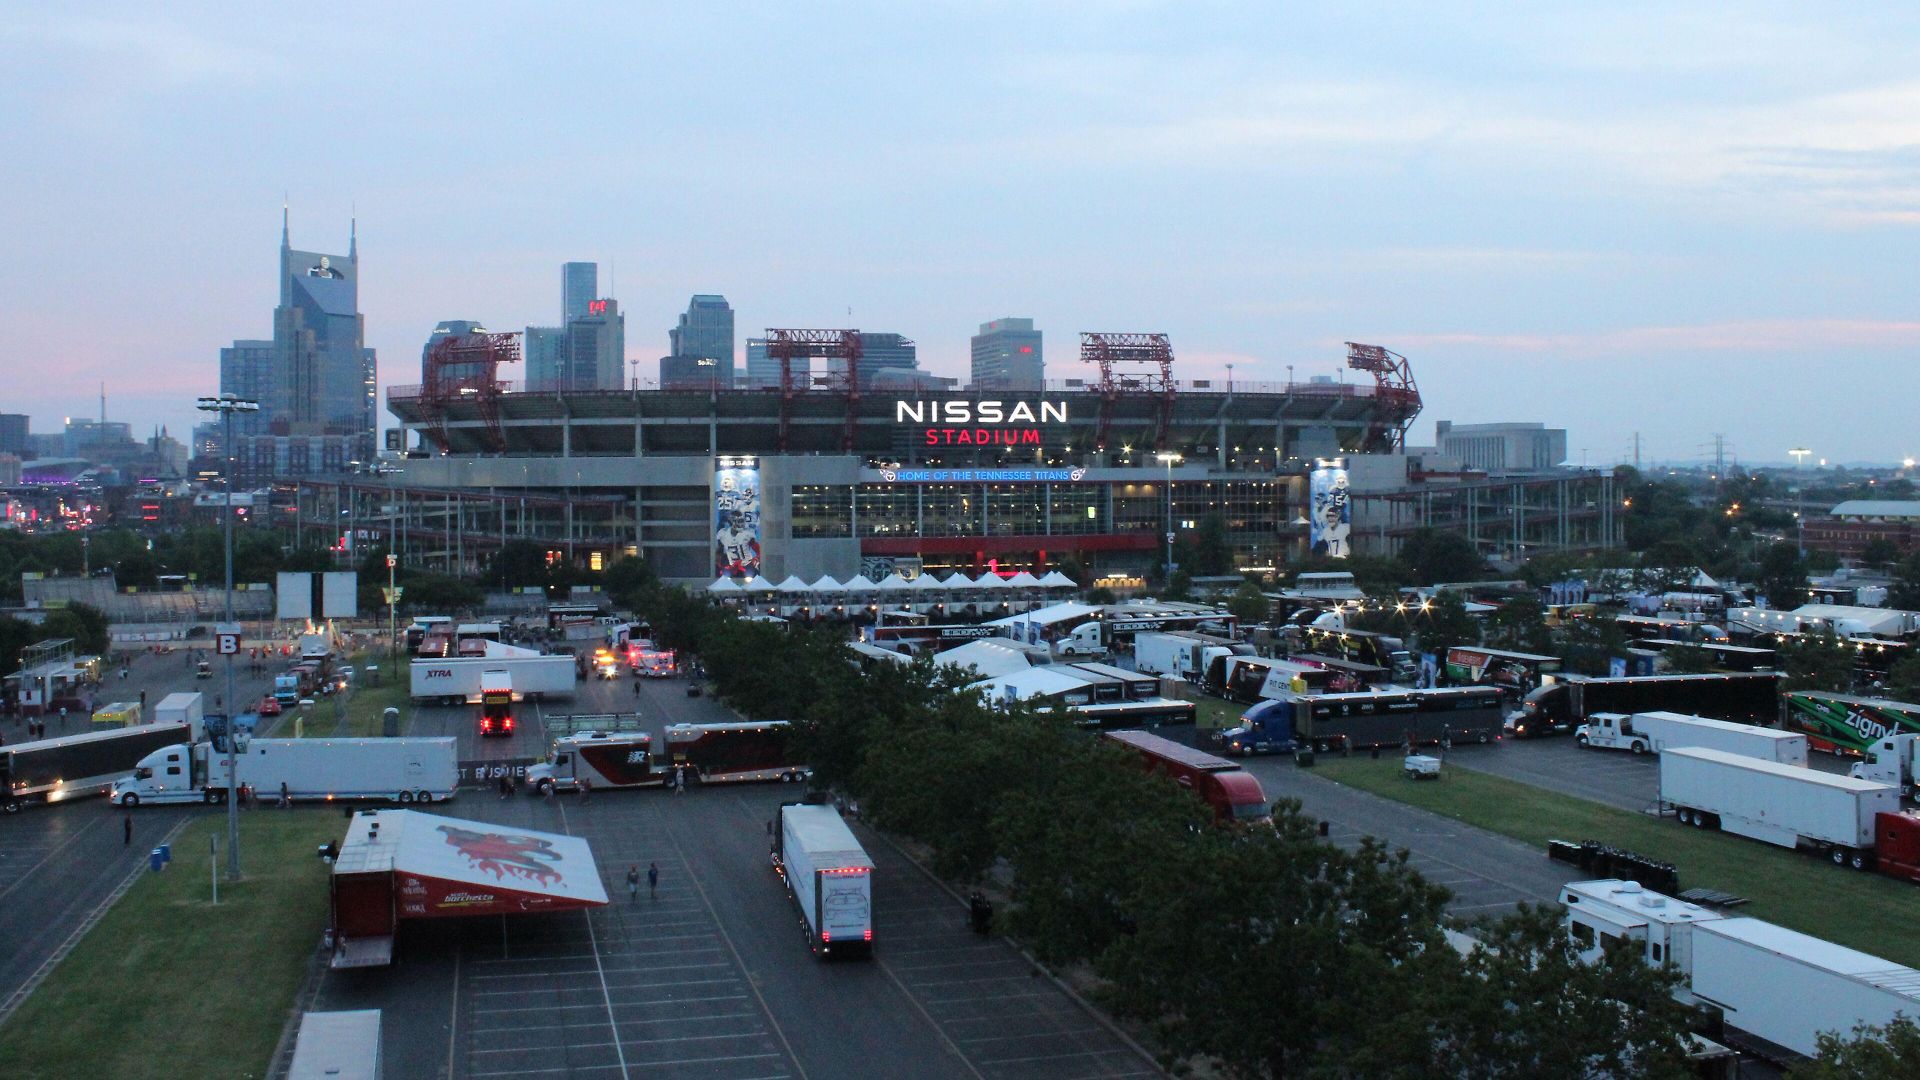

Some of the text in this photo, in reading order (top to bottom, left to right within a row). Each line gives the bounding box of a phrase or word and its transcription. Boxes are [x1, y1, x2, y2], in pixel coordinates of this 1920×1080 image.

[897, 401, 1067, 423] NISSAN
[925, 429, 1040, 445] STADIUM
[897, 471, 1068, 480] HOME OF THE TENNESSEE TITANS
[728, 545, 746, 561] 31
[220, 635, 238, 654] B
[425, 669, 453, 680] XTRA
